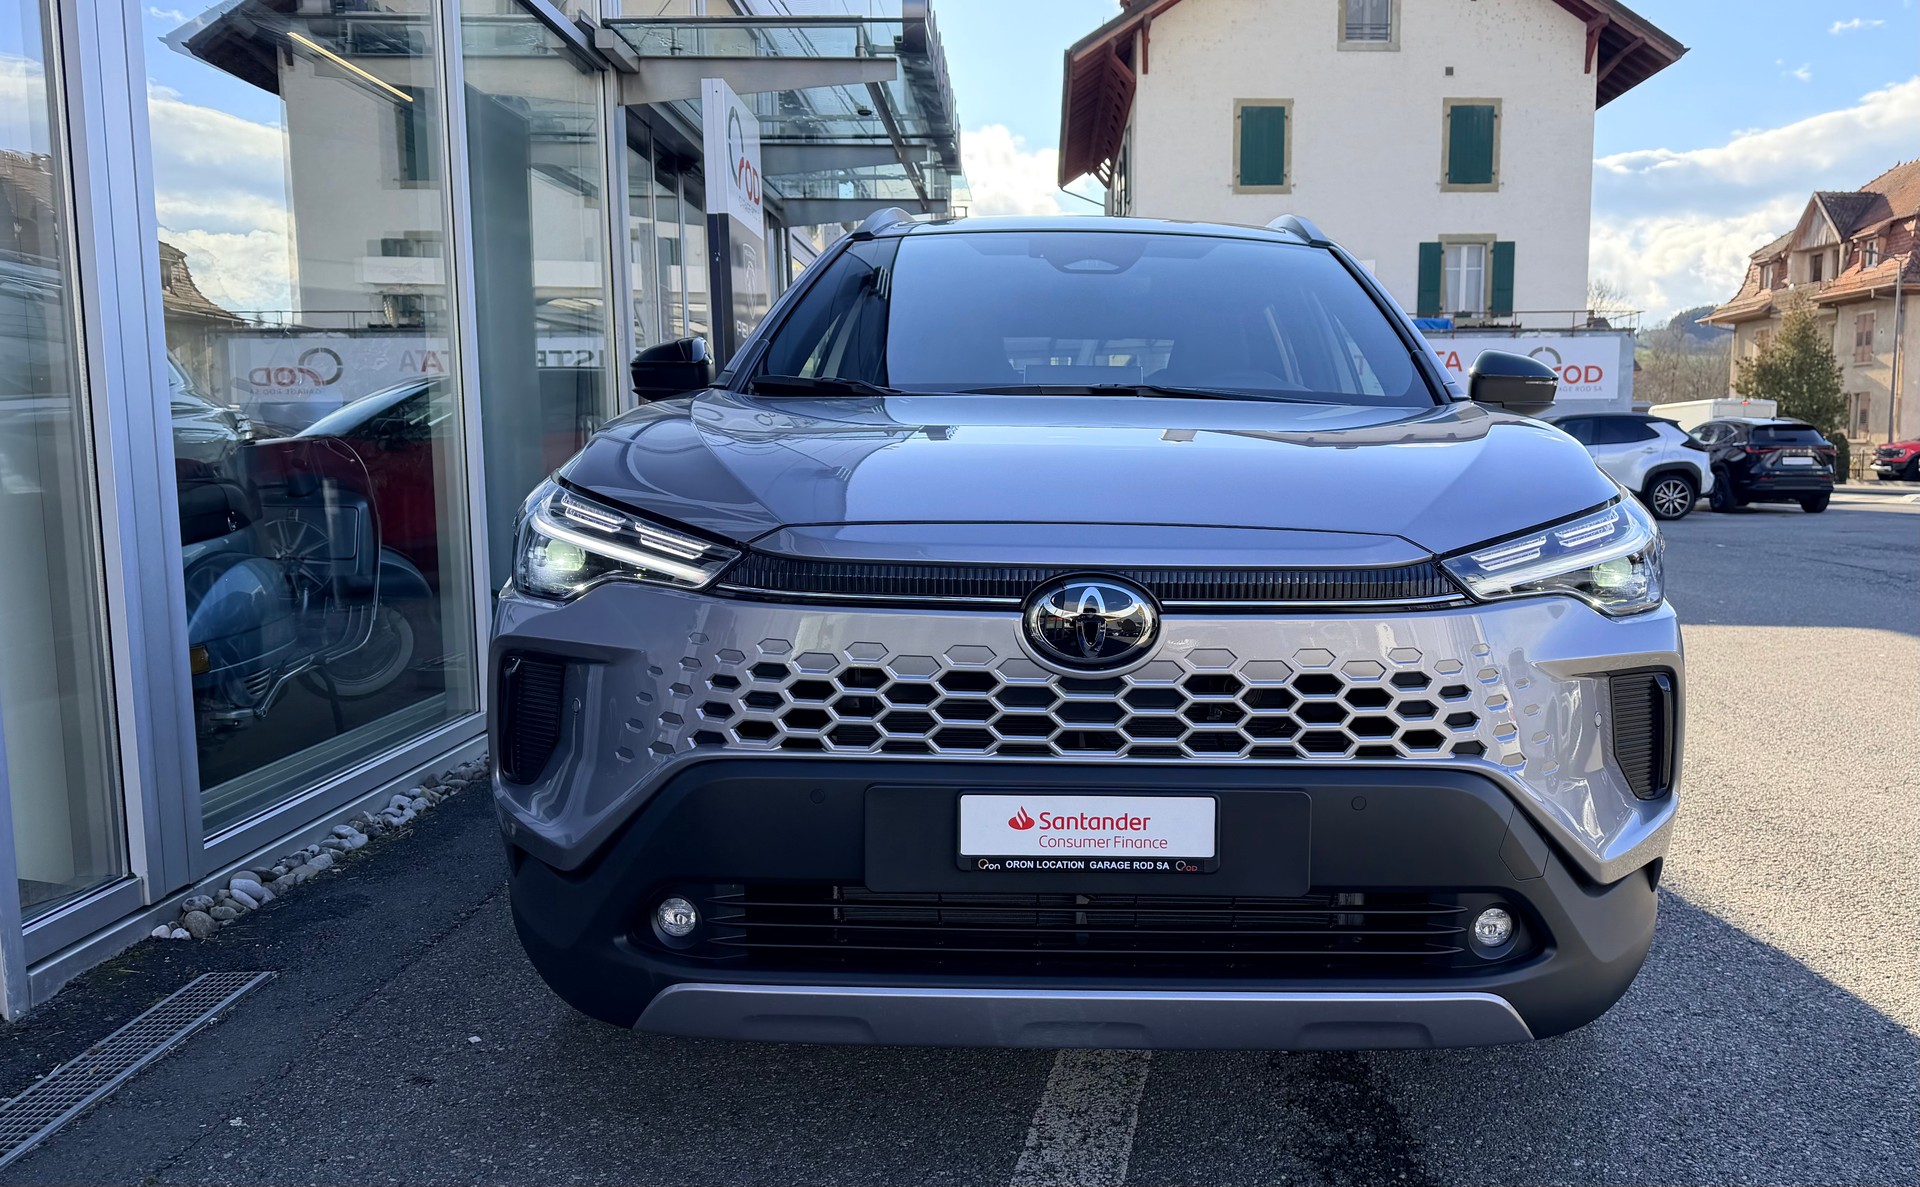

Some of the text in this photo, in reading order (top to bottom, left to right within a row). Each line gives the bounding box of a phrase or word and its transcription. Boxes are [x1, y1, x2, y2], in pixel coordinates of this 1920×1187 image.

[1039, 811, 1151, 831] Santander
[1039, 835, 1168, 849] Consumer Finance
[1005, 860, 1034, 869] ORON
[1036, 860, 1085, 869] LOCATION
[1089, 860, 1131, 869] GARAGE
[1133, 861, 1154, 870] ROD
[1156, 861, 1170, 870] SA
